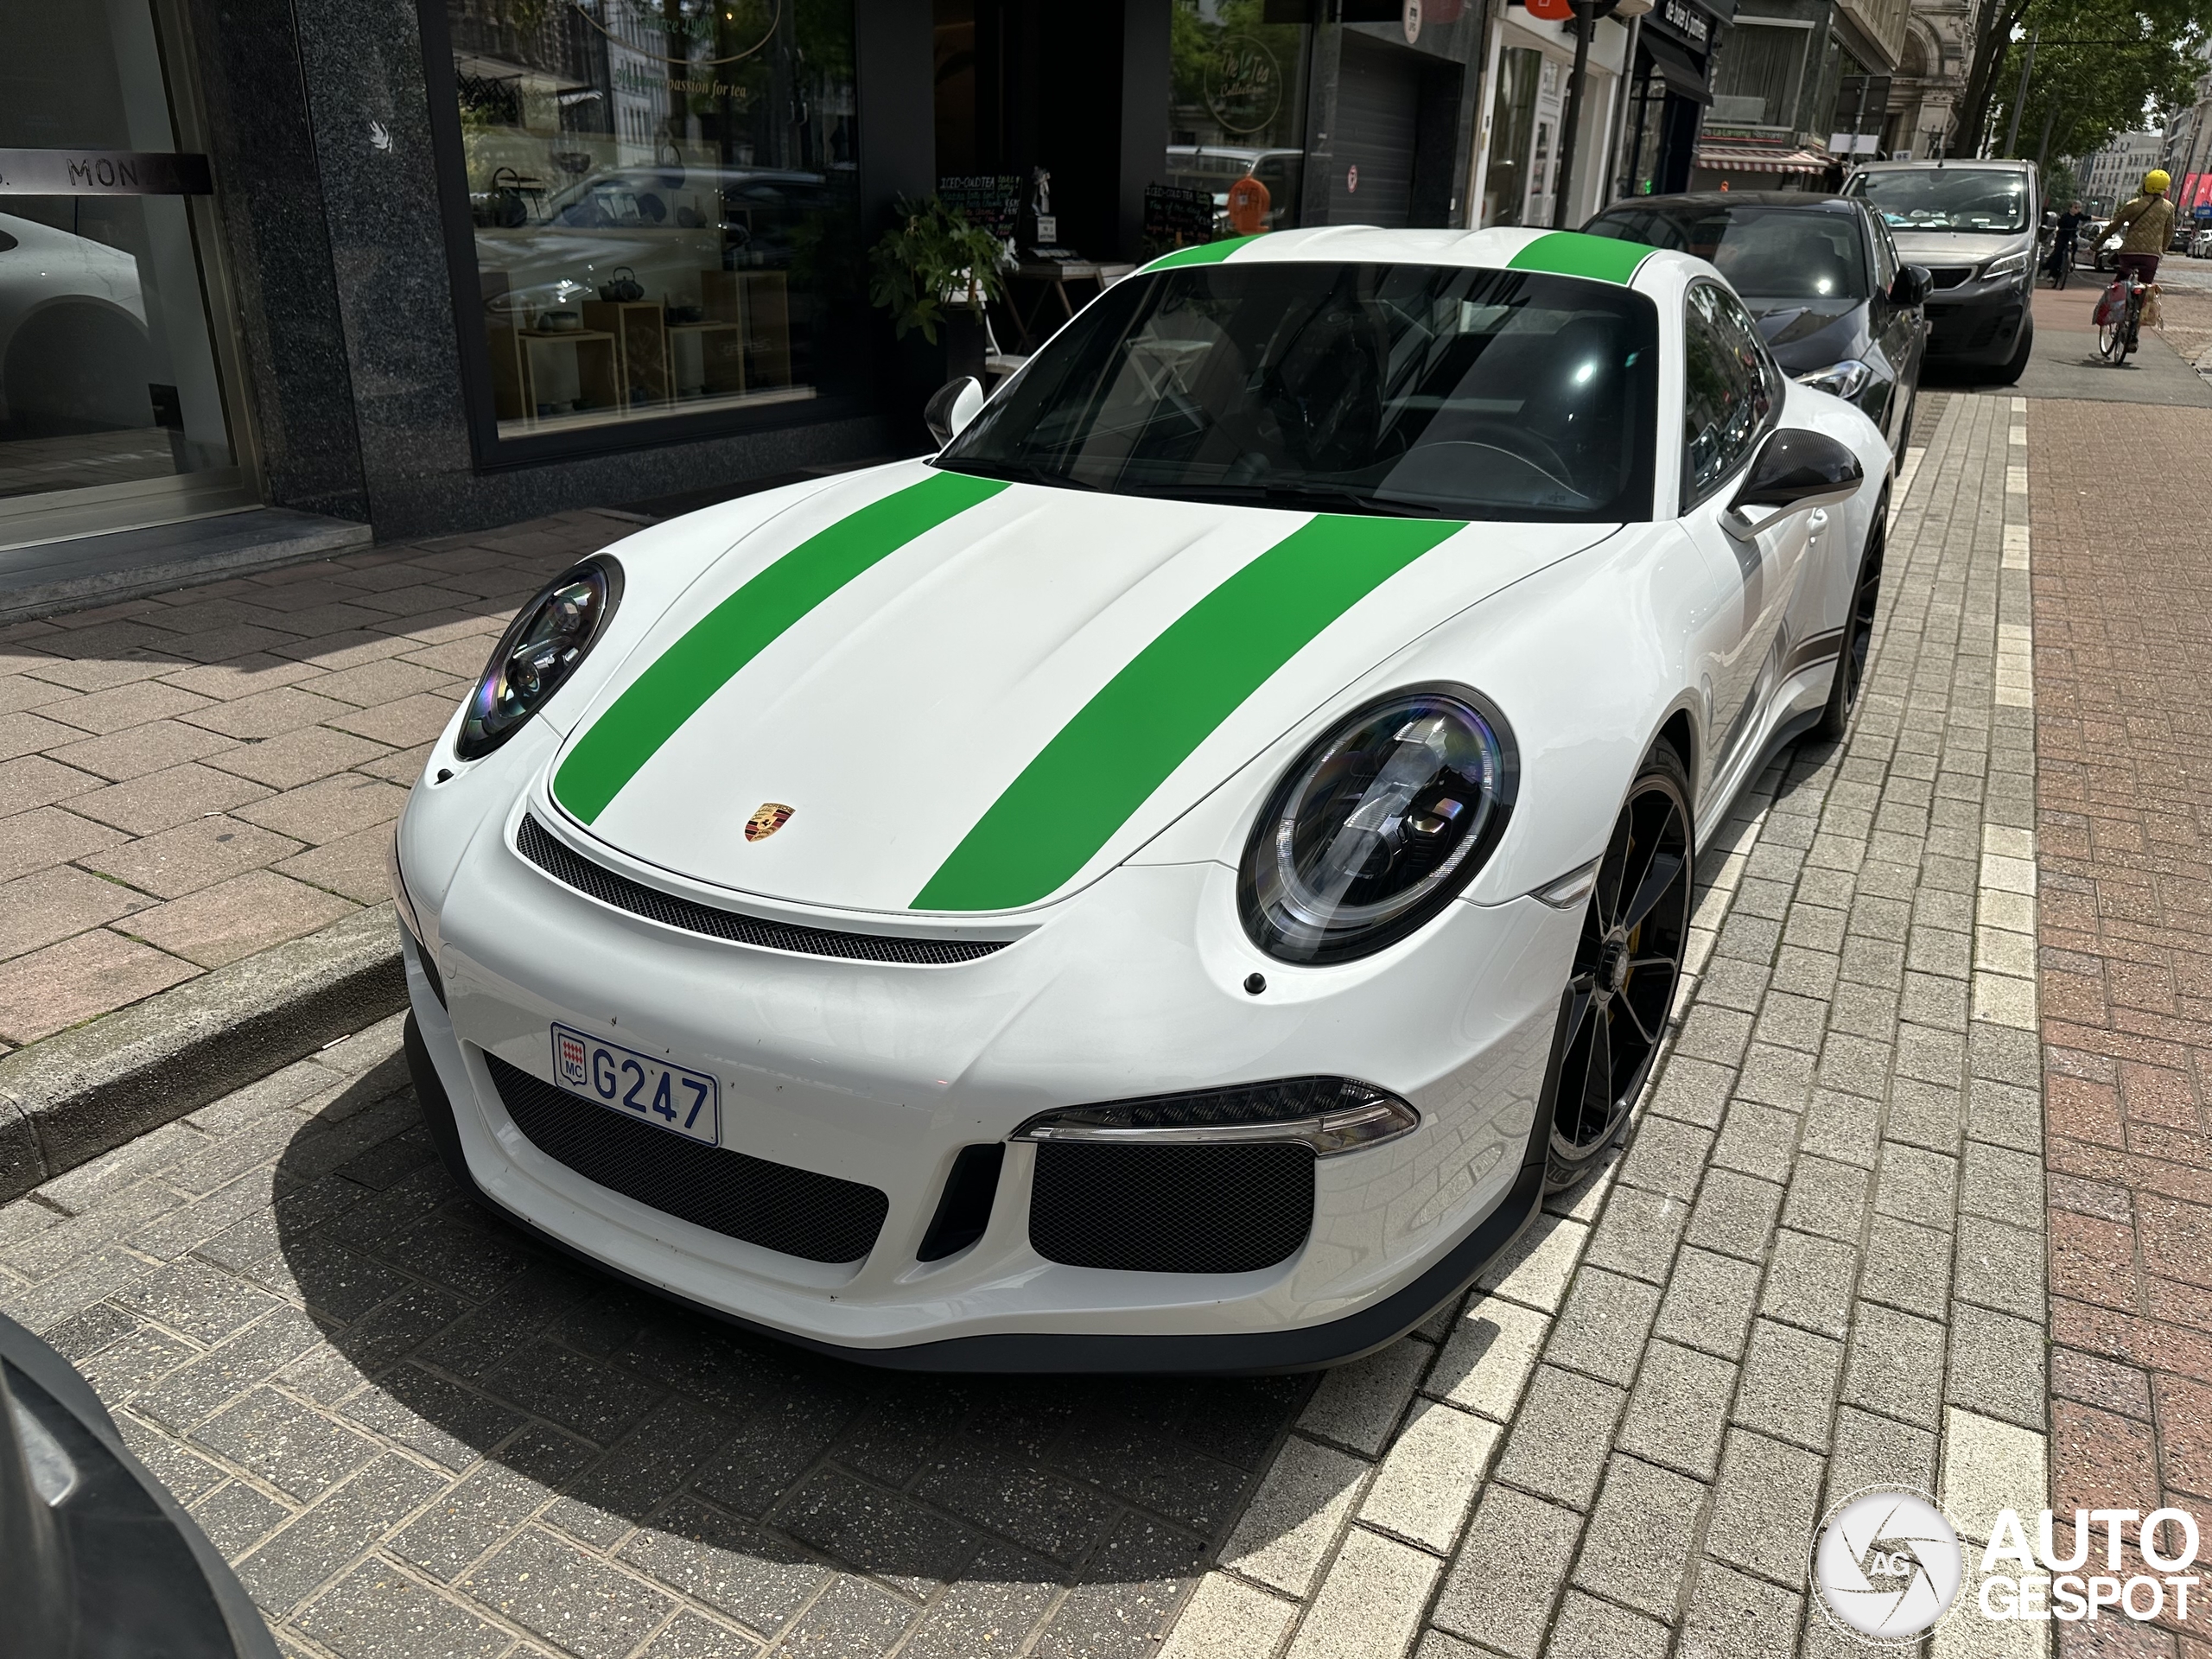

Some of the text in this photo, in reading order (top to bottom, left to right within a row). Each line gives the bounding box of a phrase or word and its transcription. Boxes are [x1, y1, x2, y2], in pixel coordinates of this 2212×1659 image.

[668, 77, 709, 93] passion
[711, 79, 728, 98] for
[730, 83, 747, 98] tea
[565, 1060, 583, 1079] MC
[593, 1048, 708, 1129] G247
